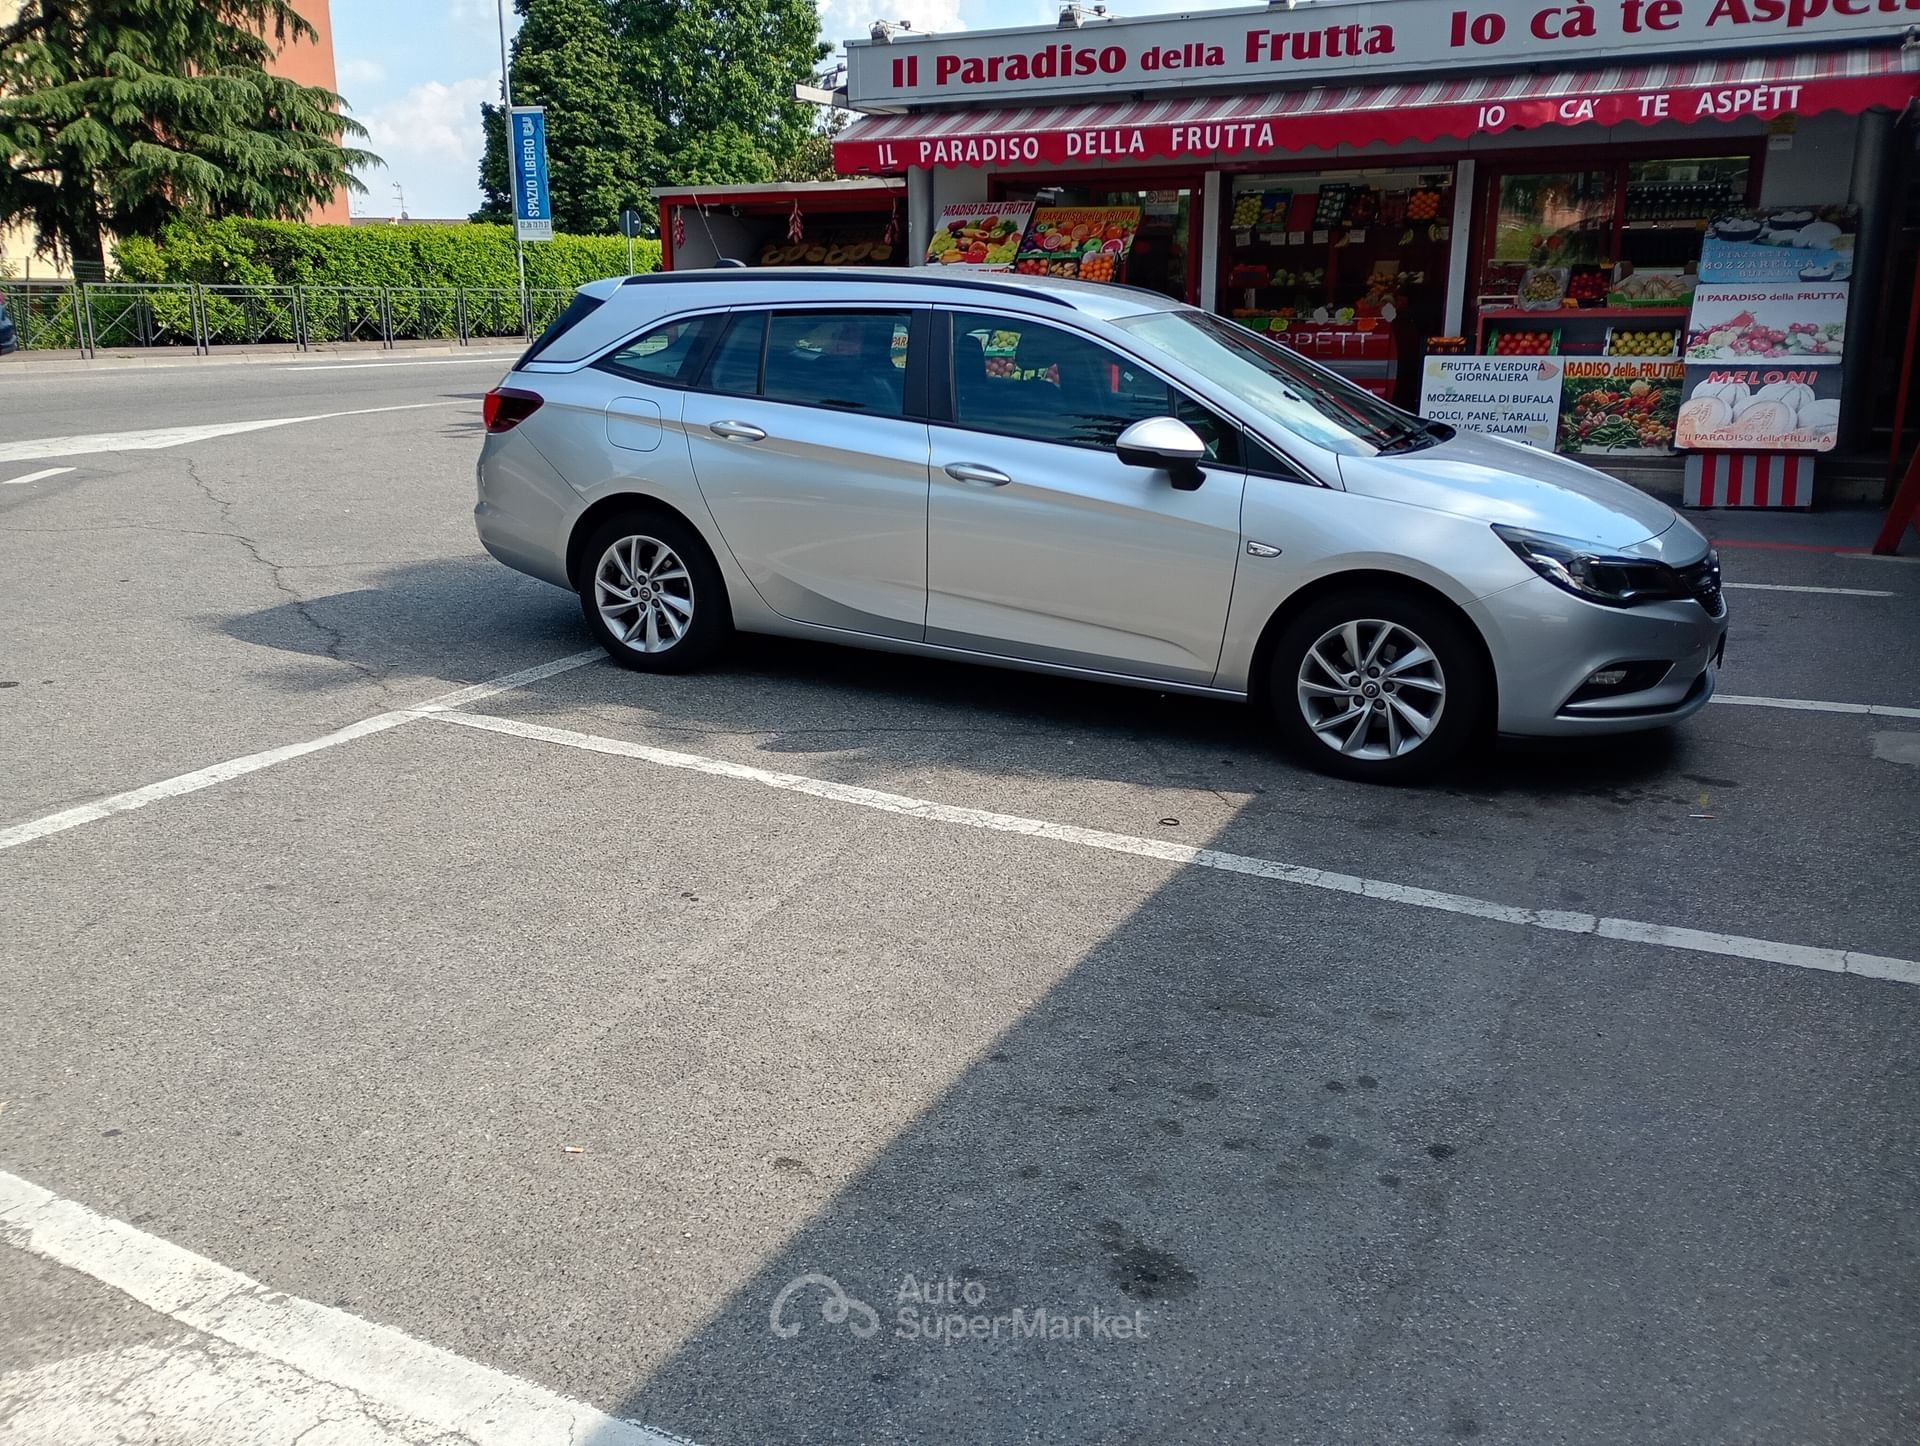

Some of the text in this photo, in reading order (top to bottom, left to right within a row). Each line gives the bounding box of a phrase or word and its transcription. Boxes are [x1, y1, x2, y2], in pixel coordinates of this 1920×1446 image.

[892, 58, 918, 88] Il
[936, 44, 1127, 86] Paradiso
[1140, 42, 1225, 71] della
[1245, 23, 1395, 63] Frutta
[1450, 10, 1506, 47] Io
[1530, 0, 1597, 40] cà
[1621, 0, 1681, 33] te
[878, 144, 898, 165] IL
[919, 137, 1040, 163] PARADISO
[1066, 129, 1145, 156] DELLA
[1171, 122, 1275, 151] FRUTTA
[1478, 105, 1506, 128] IO
[1638, 94, 1670, 117] TE
[524, 139, 537, 177] LIBERO
[528, 180, 540, 217] SPAZIO
[977, 202, 1001, 216] DELLA
[1000, 201, 1034, 215] FRUTTA
[1707, 293, 1767, 302] PARADISO
[1769, 292, 1794, 301] della
[1797, 291, 1846, 300] FRUTTA
[1440, 362, 1546, 372] FRUTTA E VERDURA
[1612, 362, 1638, 377] della
[1639, 362, 1686, 377] FRUTTA
[1455, 373, 1529, 382] GIORNALIERA
[1707, 370, 1818, 385] MELONI
[1427, 393, 1554, 404] MOZZARELLA DI BUFALA
[1428, 410, 1549, 423] DOLCI, PANE, TARALLI,
[1486, 424, 1528, 434] SALAMI
[1694, 433, 1753, 442] PARADISO
[1756, 433, 1781, 442] della
